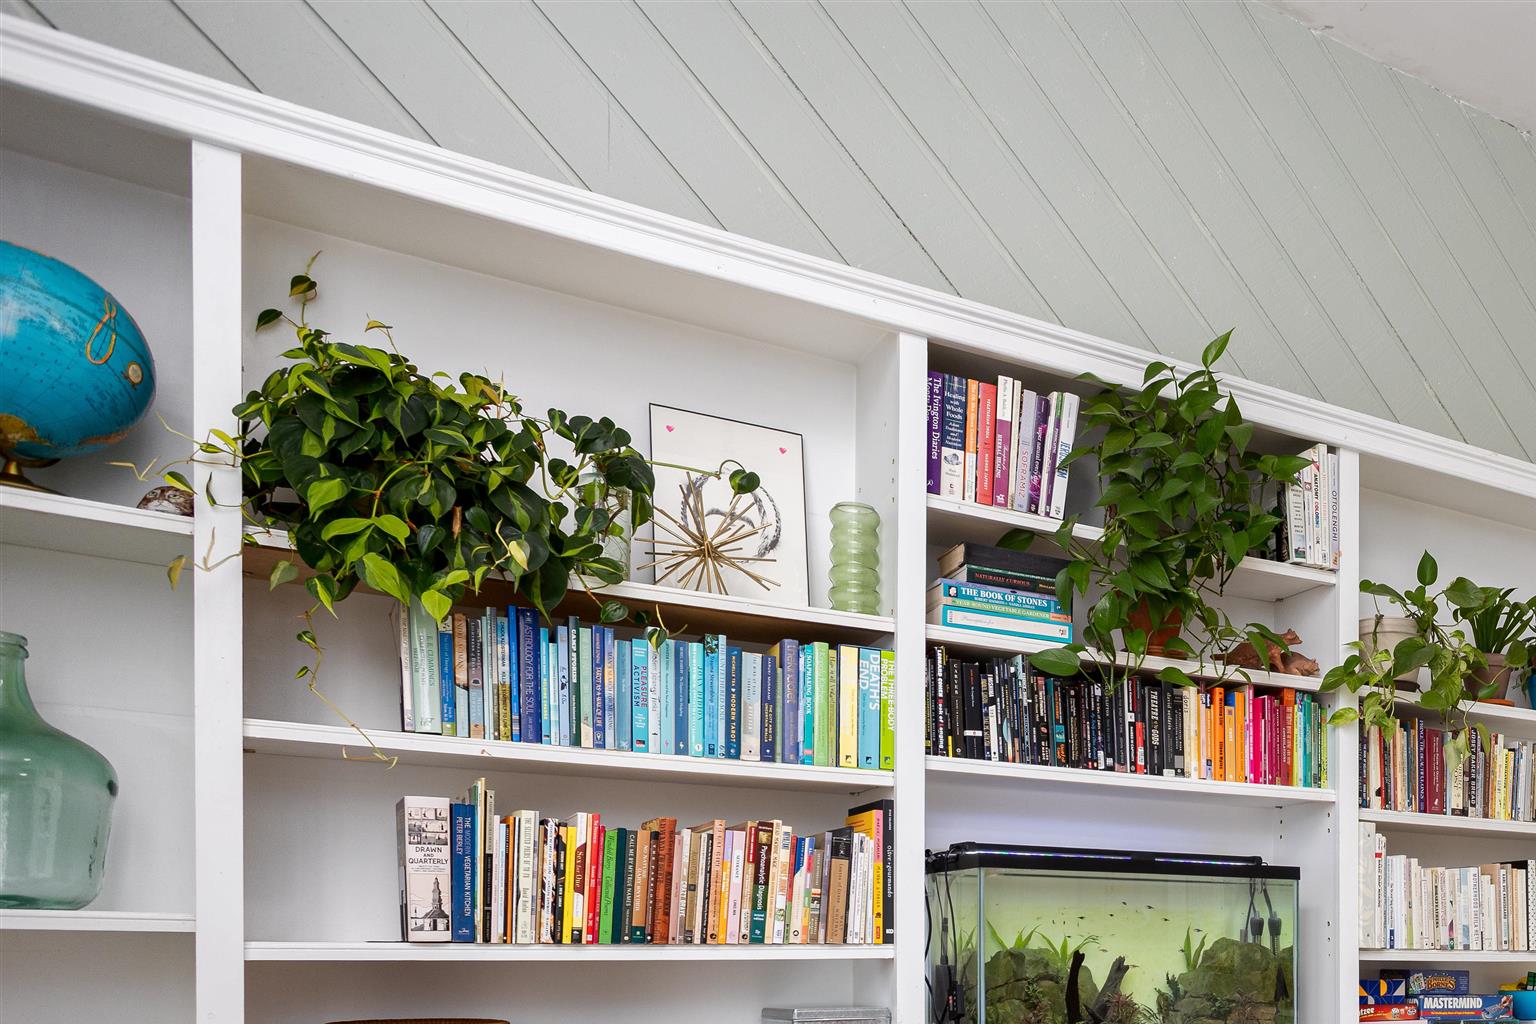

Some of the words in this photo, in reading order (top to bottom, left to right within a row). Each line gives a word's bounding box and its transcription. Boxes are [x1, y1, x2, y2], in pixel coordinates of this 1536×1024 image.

[932, 396, 940, 429] Ivington
[932, 432, 940, 459] Diaries
[1019, 449, 1028, 498] SOFRAMIZ
[961, 587, 978, 596] THE
[980, 589, 1002, 600] BOOK
[1006, 592, 1016, 602] OF
[1018, 594, 1048, 607] STONES
[992, 605, 1022, 614] VEGETABLE
[525, 625, 533, 664] ASTROLOGY
[860, 660, 870, 690] END
[870, 654, 880, 710] DEATH'S
[1150, 691, 1158, 720] THEATRE
[629, 848, 634, 856] ME
[758, 846, 768, 884] Psychoanalytic
[628, 865, 634, 874] MY
[756, 885, 765, 910] Diagnosis
[1424, 997, 1482, 1009] MASTERMIND
